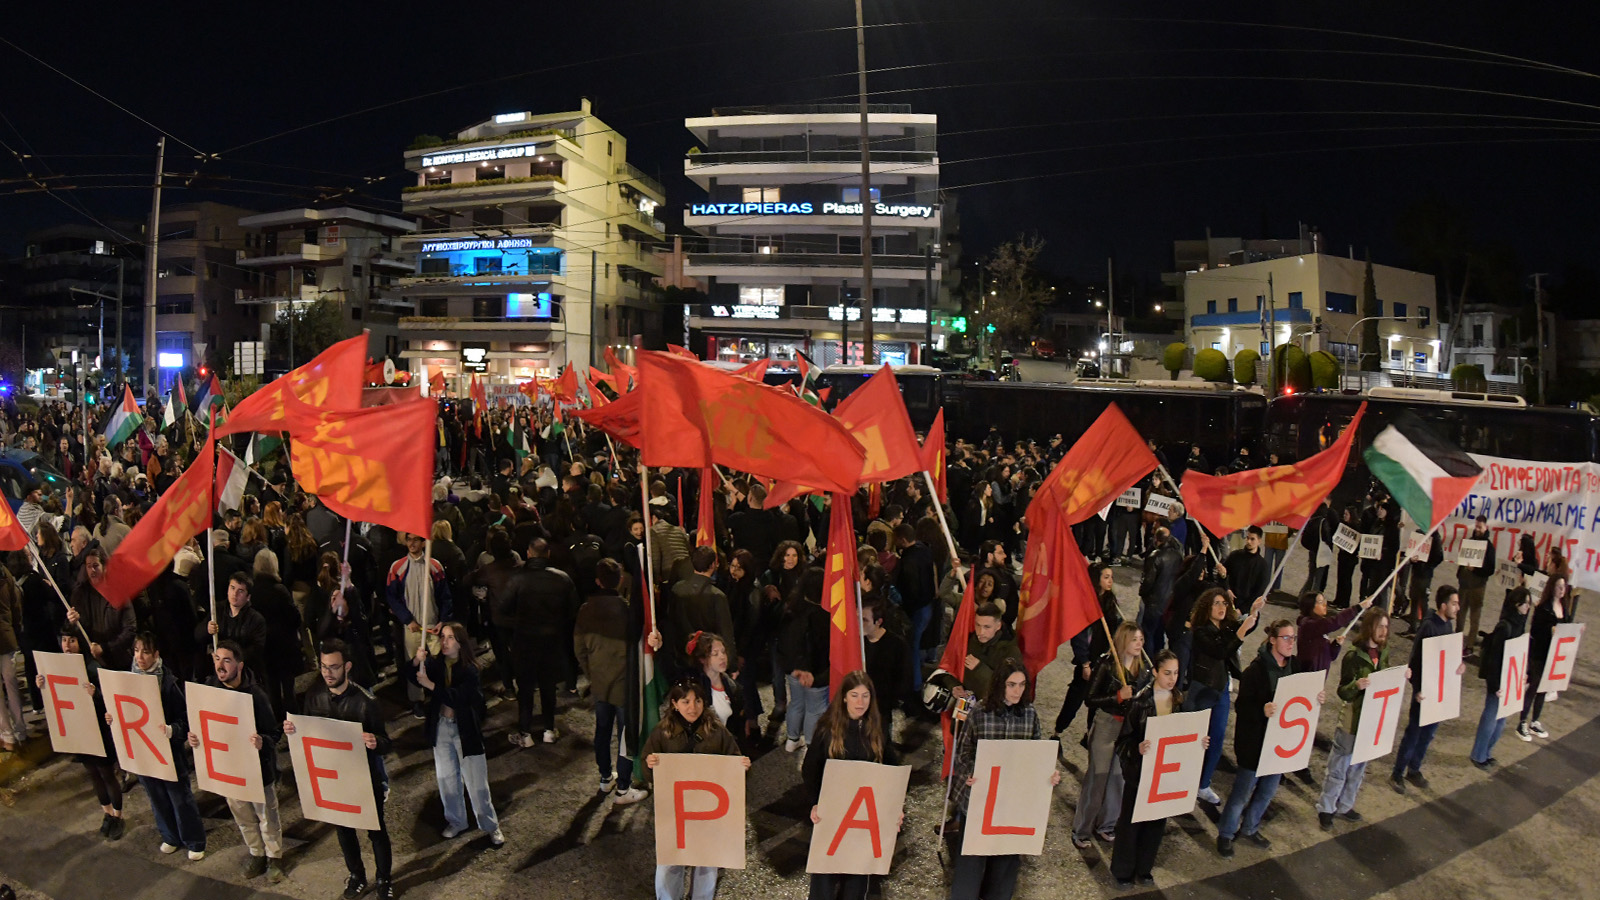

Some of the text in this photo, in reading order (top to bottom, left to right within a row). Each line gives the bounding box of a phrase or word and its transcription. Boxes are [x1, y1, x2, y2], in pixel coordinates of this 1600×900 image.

[465, 150, 497, 162] MEDICAL
[498, 147, 525, 159] GROUP
[692, 202, 931, 217] HATZIPIERAS Plasti Surgery
[1158, 501, 1170, 510] ΓΑΖ
[1490, 463, 1581, 493] ΣΥΜΦΕΡΟΝΤΑ
[1494, 497, 1535, 523] ΧΕΡΙΑ
[1536, 501, 1563, 527] ΜΑΣ
[1566, 503, 1587, 530] ΜΕ
[1437, 649, 1446, 702] I
[1503, 655, 1527, 706] N
[1548, 636, 1576, 681] E
[47, 674, 79, 737] F
[113, 693, 168, 766] R
[1274, 696, 1312, 759] S
[1372, 686, 1399, 746] T
[199, 710, 247, 787] E
[301, 736, 361, 814] E
[1147, 733, 1198, 804] E
[673, 780, 730, 849] P
[826, 786, 882, 859] A
[980, 766, 1036, 836] L
